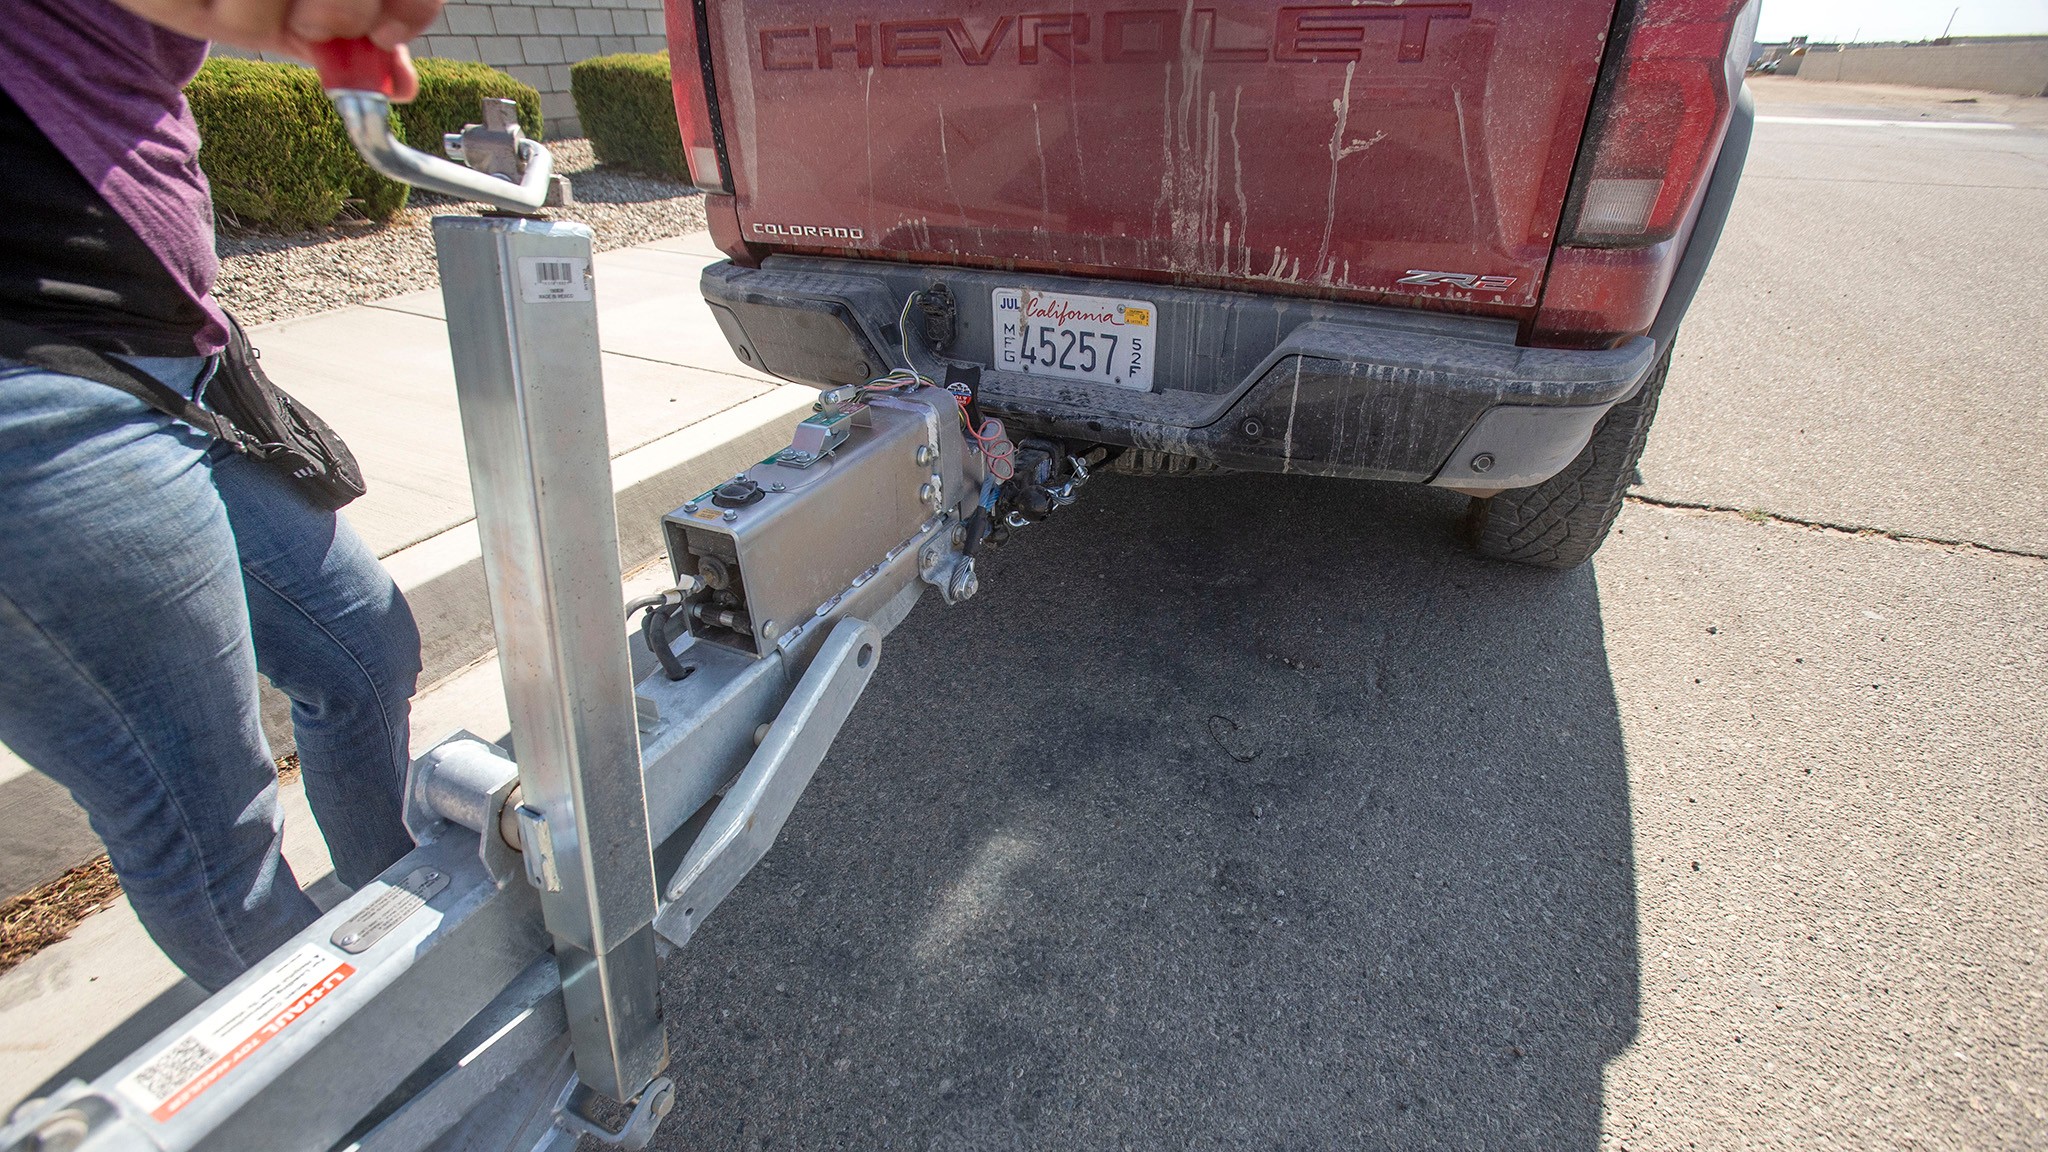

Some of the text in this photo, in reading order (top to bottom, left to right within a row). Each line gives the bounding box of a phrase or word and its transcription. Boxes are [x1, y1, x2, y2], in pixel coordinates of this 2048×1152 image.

[759, 3, 1472, 71] CHEVROLET
[752, 223, 863, 239] COLORADO
[1397, 270, 1517, 291] ZR2
[1000, 298, 1020, 310] JUL
[1026, 297, 1125, 326] California
[1004, 323, 1016, 363] MFG
[1020, 325, 1118, 375] 45257
[1129, 338, 1142, 378] 52F
[261, 972, 345, 1034] U-HAUL
